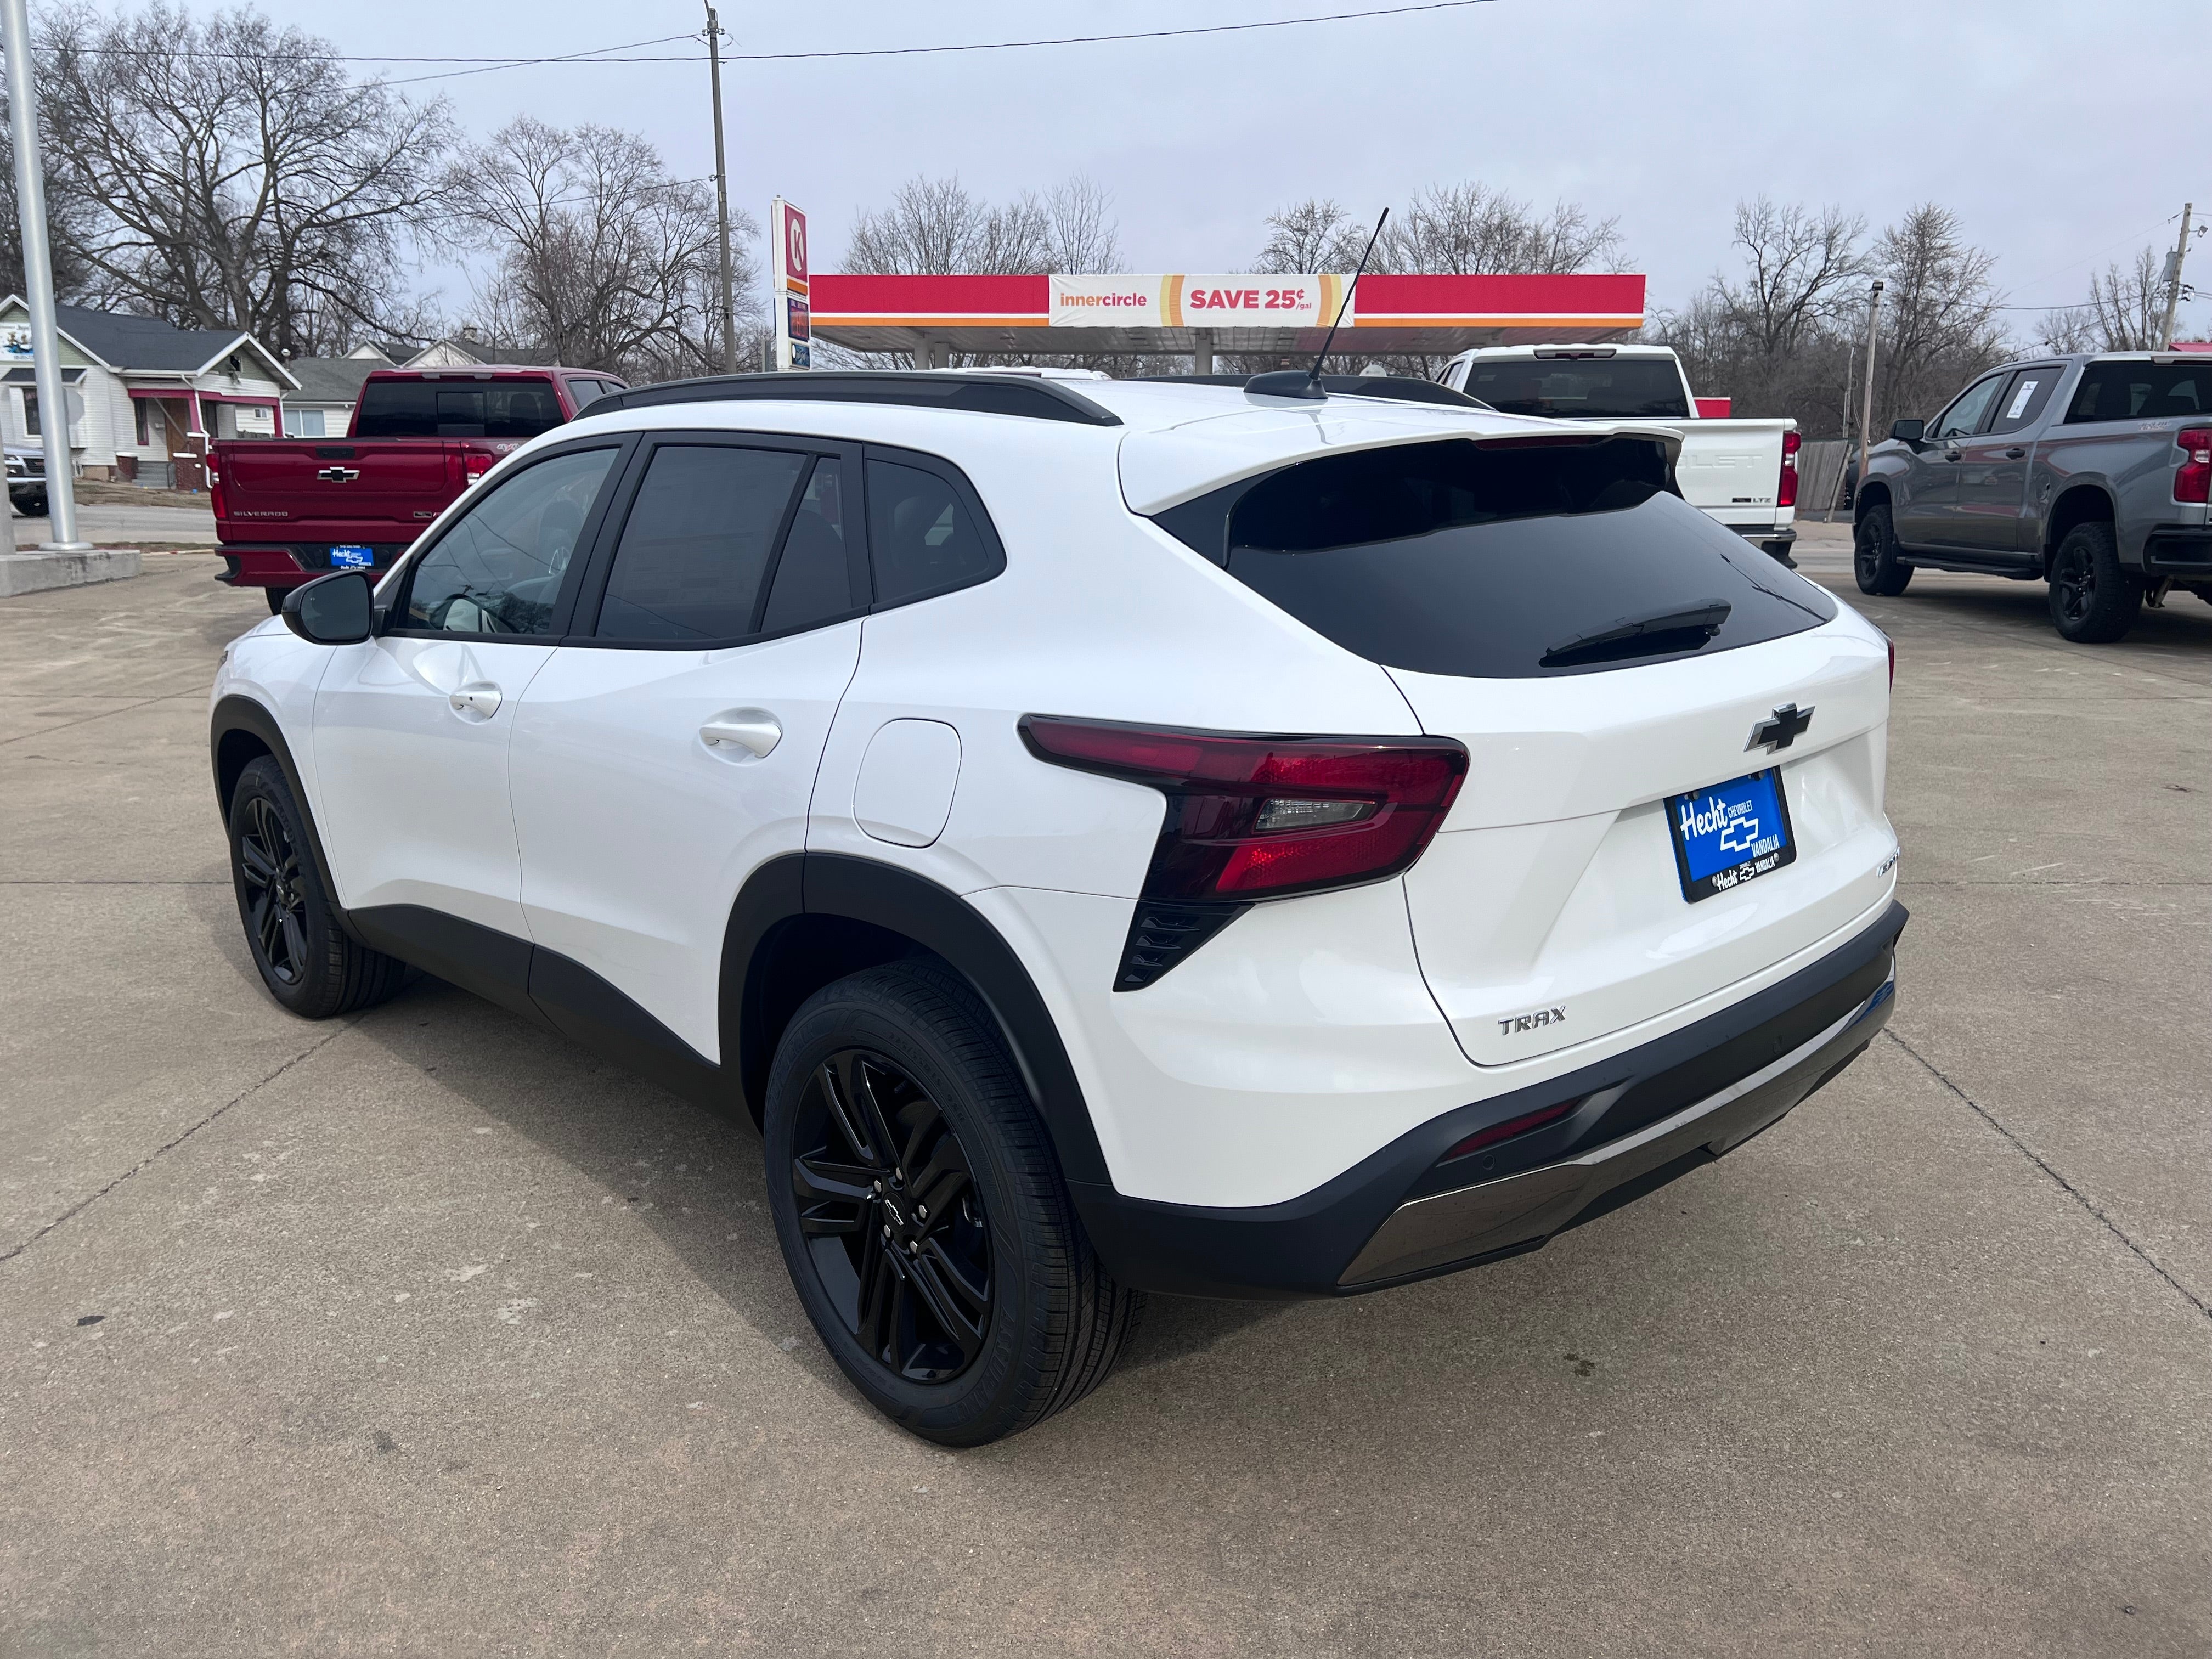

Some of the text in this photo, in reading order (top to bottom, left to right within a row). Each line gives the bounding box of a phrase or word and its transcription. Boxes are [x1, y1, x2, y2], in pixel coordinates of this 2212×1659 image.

[1060, 292, 1147, 307] innercircle
[1189, 290, 1260, 309] SAVE
[332, 549, 351, 557] Hecht
[1680, 796, 1728, 841] Hecht
[1727, 799, 1753, 819] CHEVROLET
[1751, 833, 1780, 858] VANDALIA
[1754, 856, 1776, 873] VANDALIA
[1717, 869, 1738, 891] Hecht
[1498, 1005, 1566, 1036] TRAX
